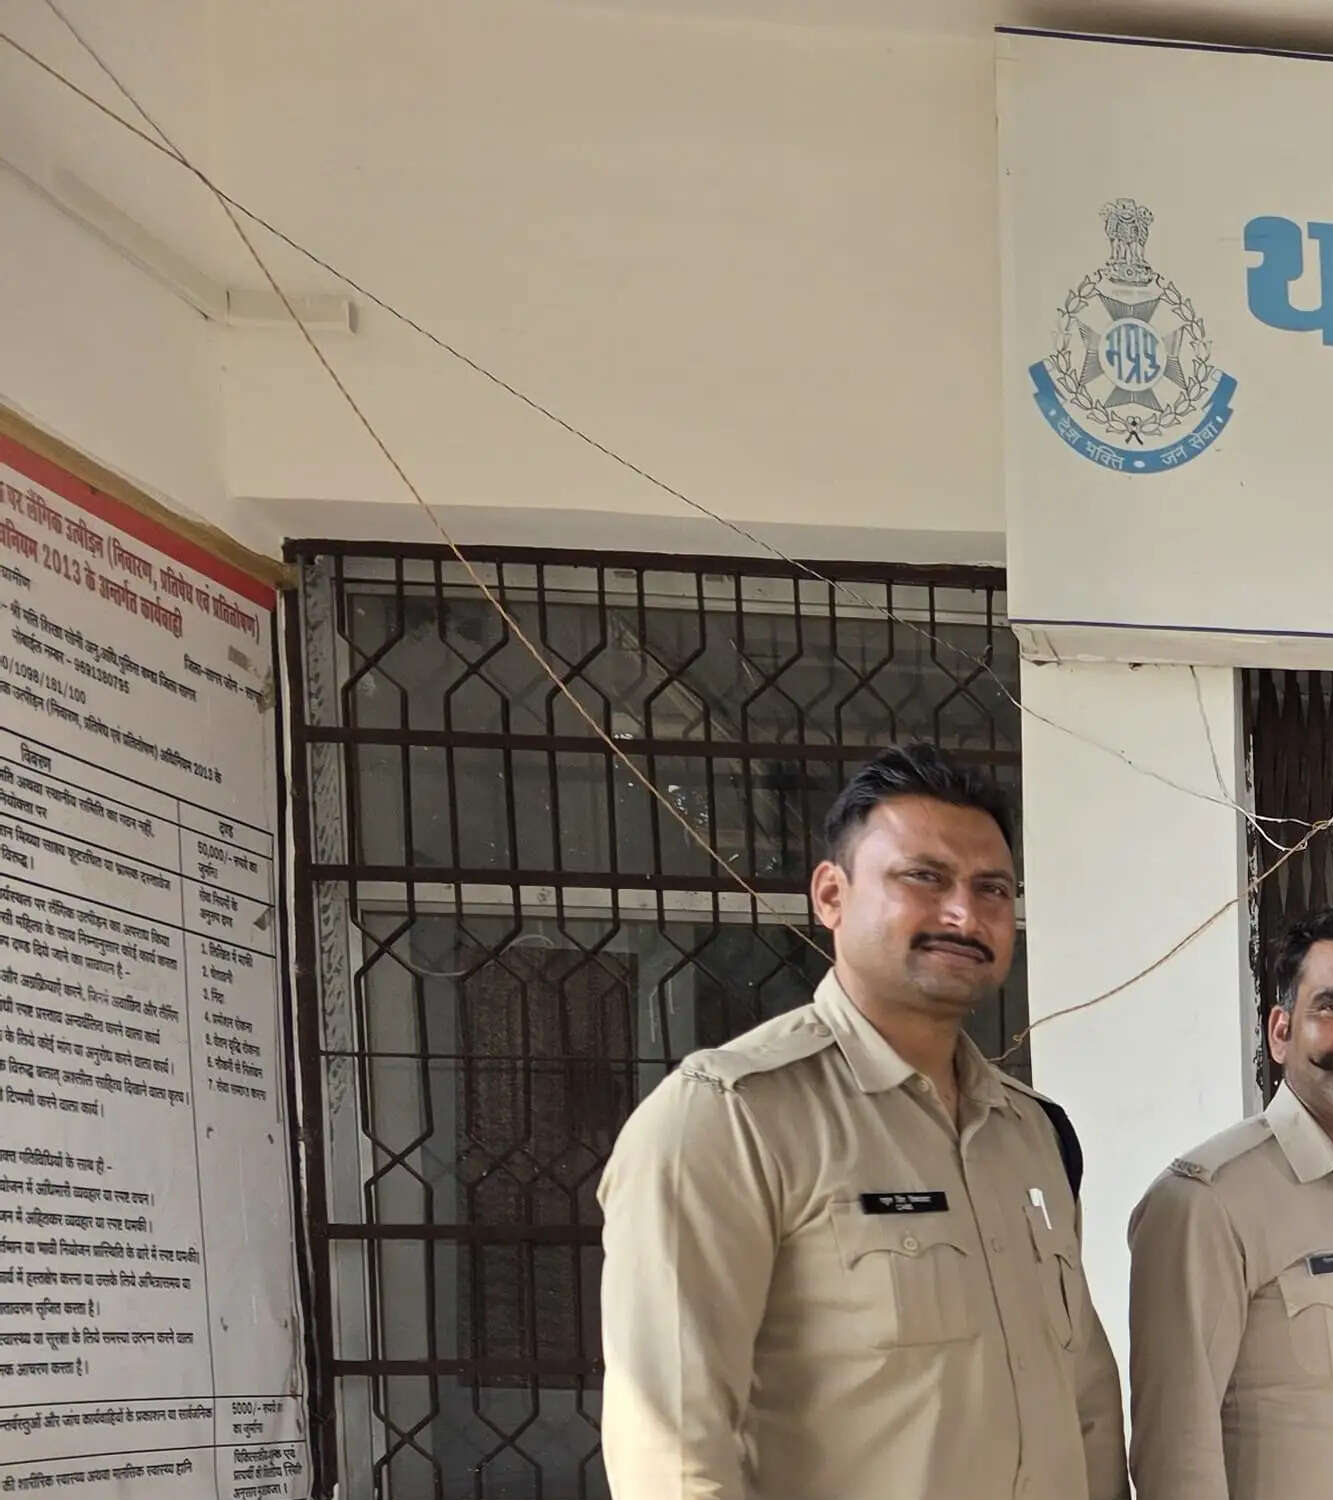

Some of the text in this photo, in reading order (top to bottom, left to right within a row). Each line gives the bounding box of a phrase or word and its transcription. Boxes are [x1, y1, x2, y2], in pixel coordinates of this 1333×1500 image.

[1160, 445, 1188, 466] जन
[1188, 422, 1219, 450] सेवा
[41, 543, 82, 586] 2013
[83, 559, 97, 592] के
